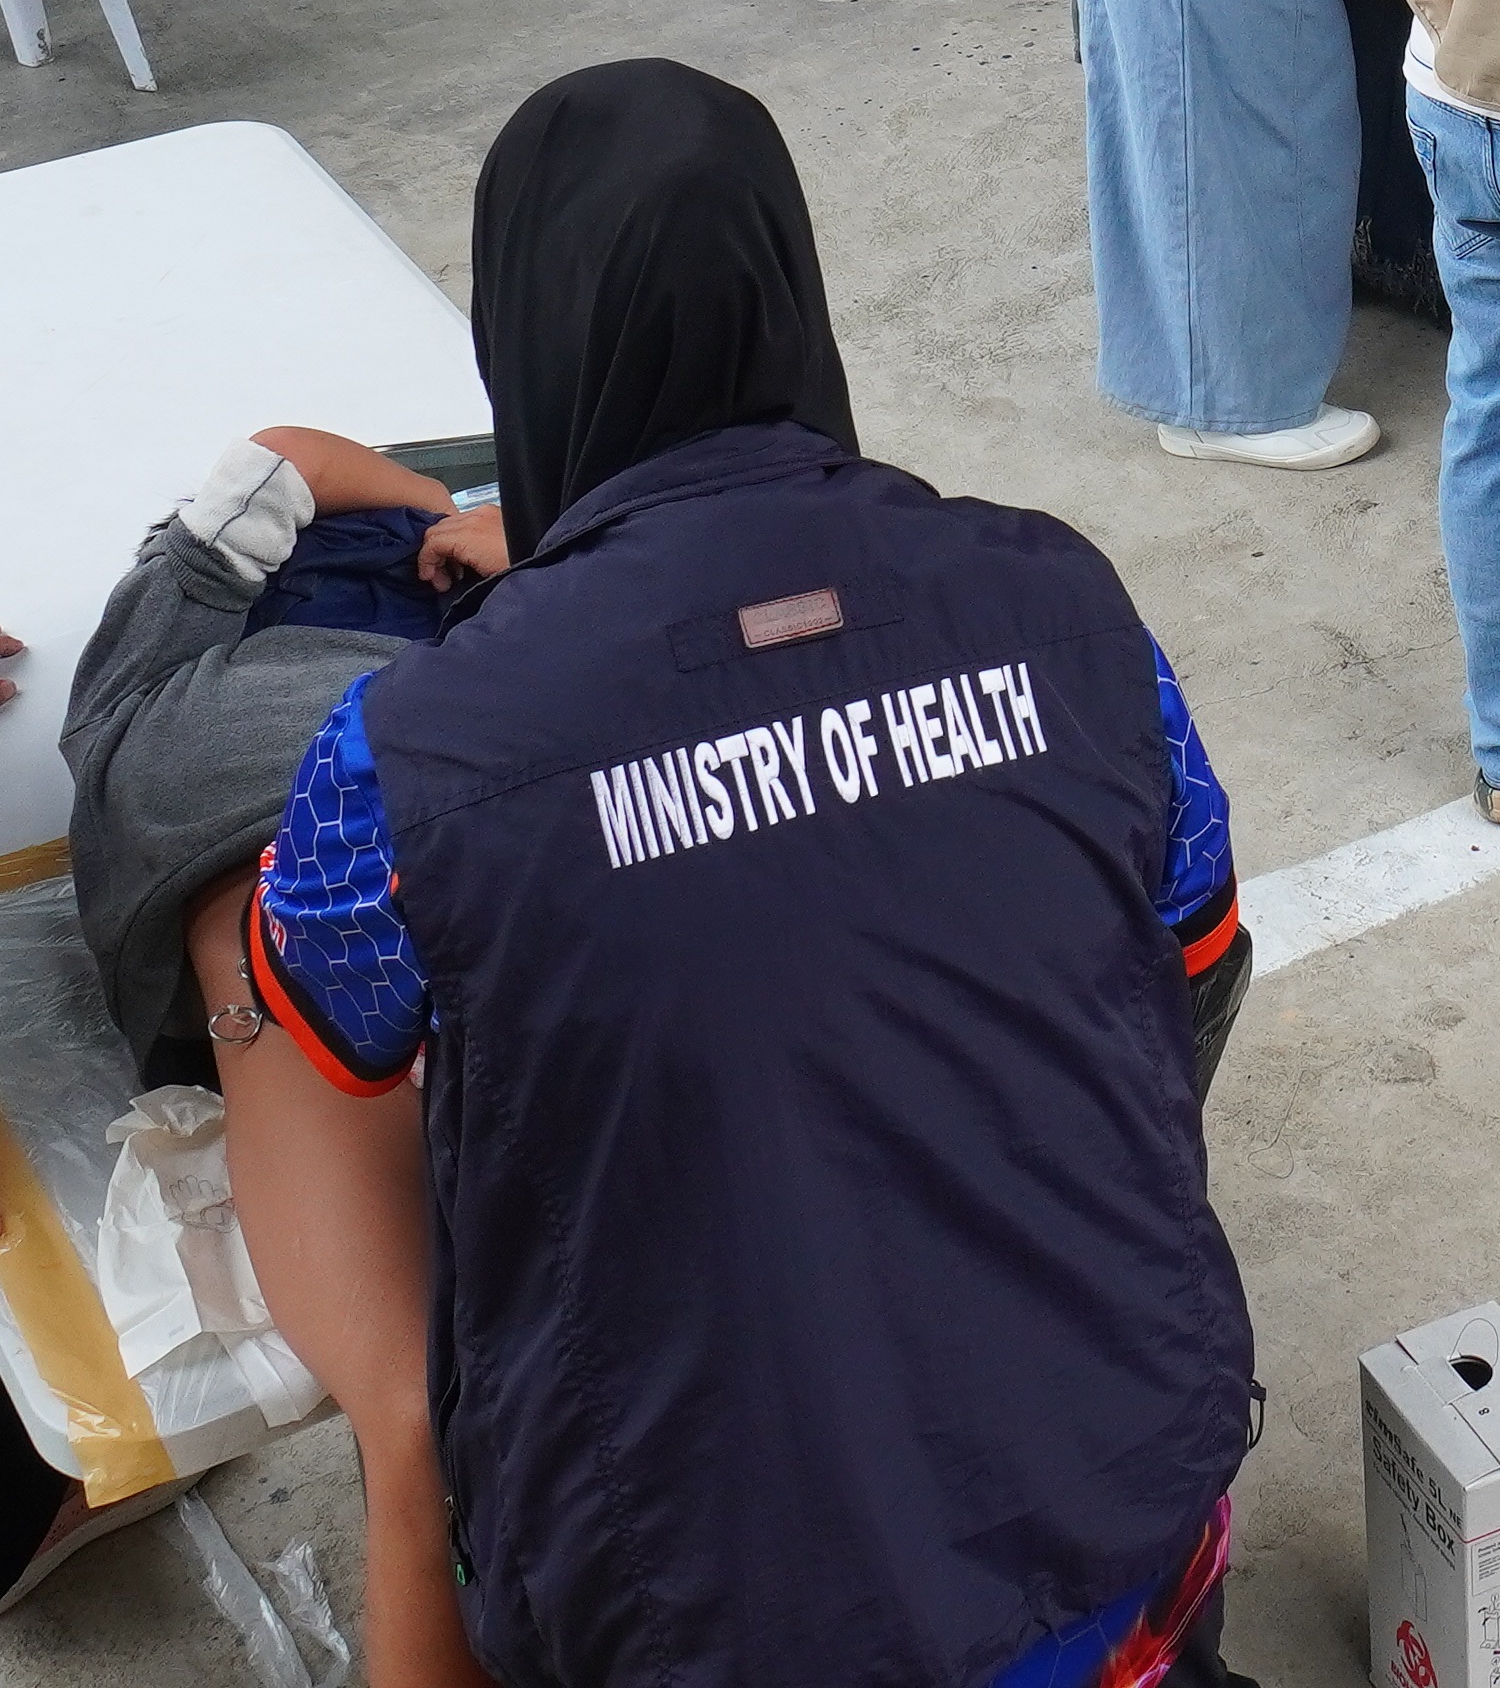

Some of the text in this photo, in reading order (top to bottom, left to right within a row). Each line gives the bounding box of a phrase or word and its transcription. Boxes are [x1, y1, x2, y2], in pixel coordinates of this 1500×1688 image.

[590, 662, 1048, 869] MINISTRY OF HEALTH
[1371, 1435, 1421, 1512] Safety
[1424, 1501, 1457, 1558] Box
